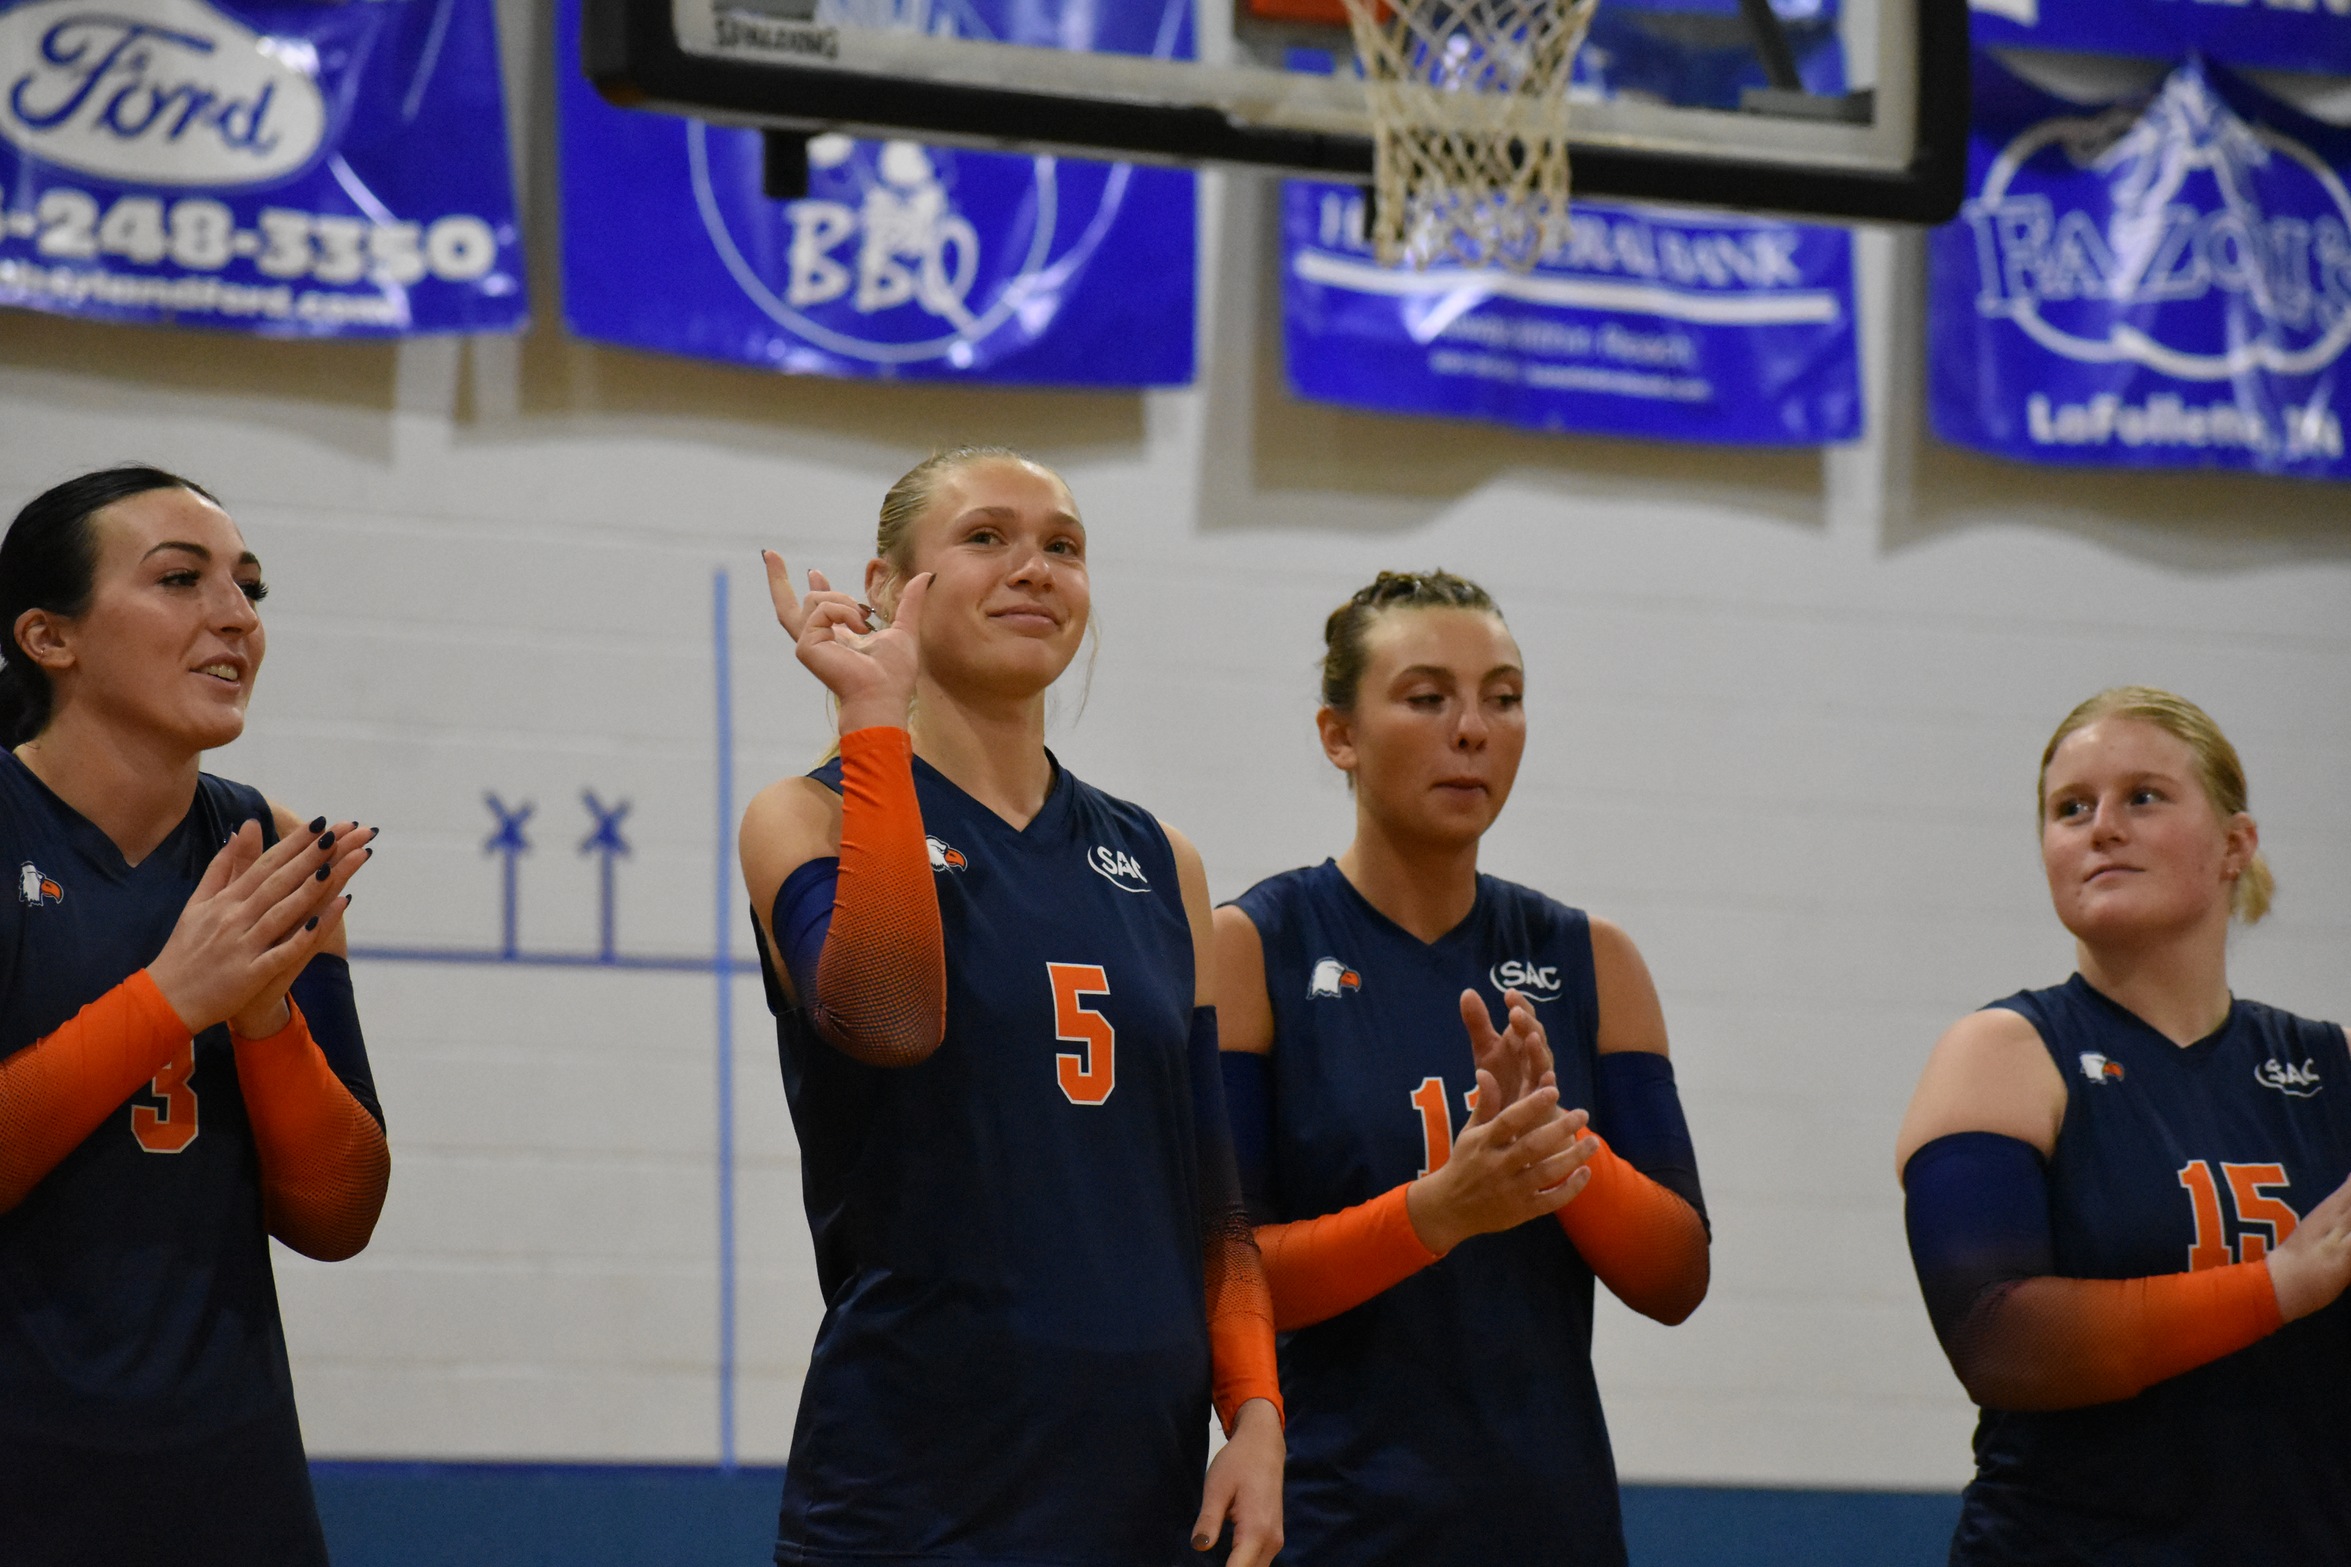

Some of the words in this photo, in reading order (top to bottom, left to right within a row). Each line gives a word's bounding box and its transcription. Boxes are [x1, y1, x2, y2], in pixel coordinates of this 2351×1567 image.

[10, 12, 280, 155] Ford
[0, 187, 497, 285] -248-3350
[785, 192, 983, 335] BBQ
[1500, 960, 1562, 991] SAC
[1046, 961, 1115, 1106] 5
[130, 1038, 199, 1153] 3
[1410, 1076, 1480, 1180] 1
[2177, 1159, 2301, 1273] 15
